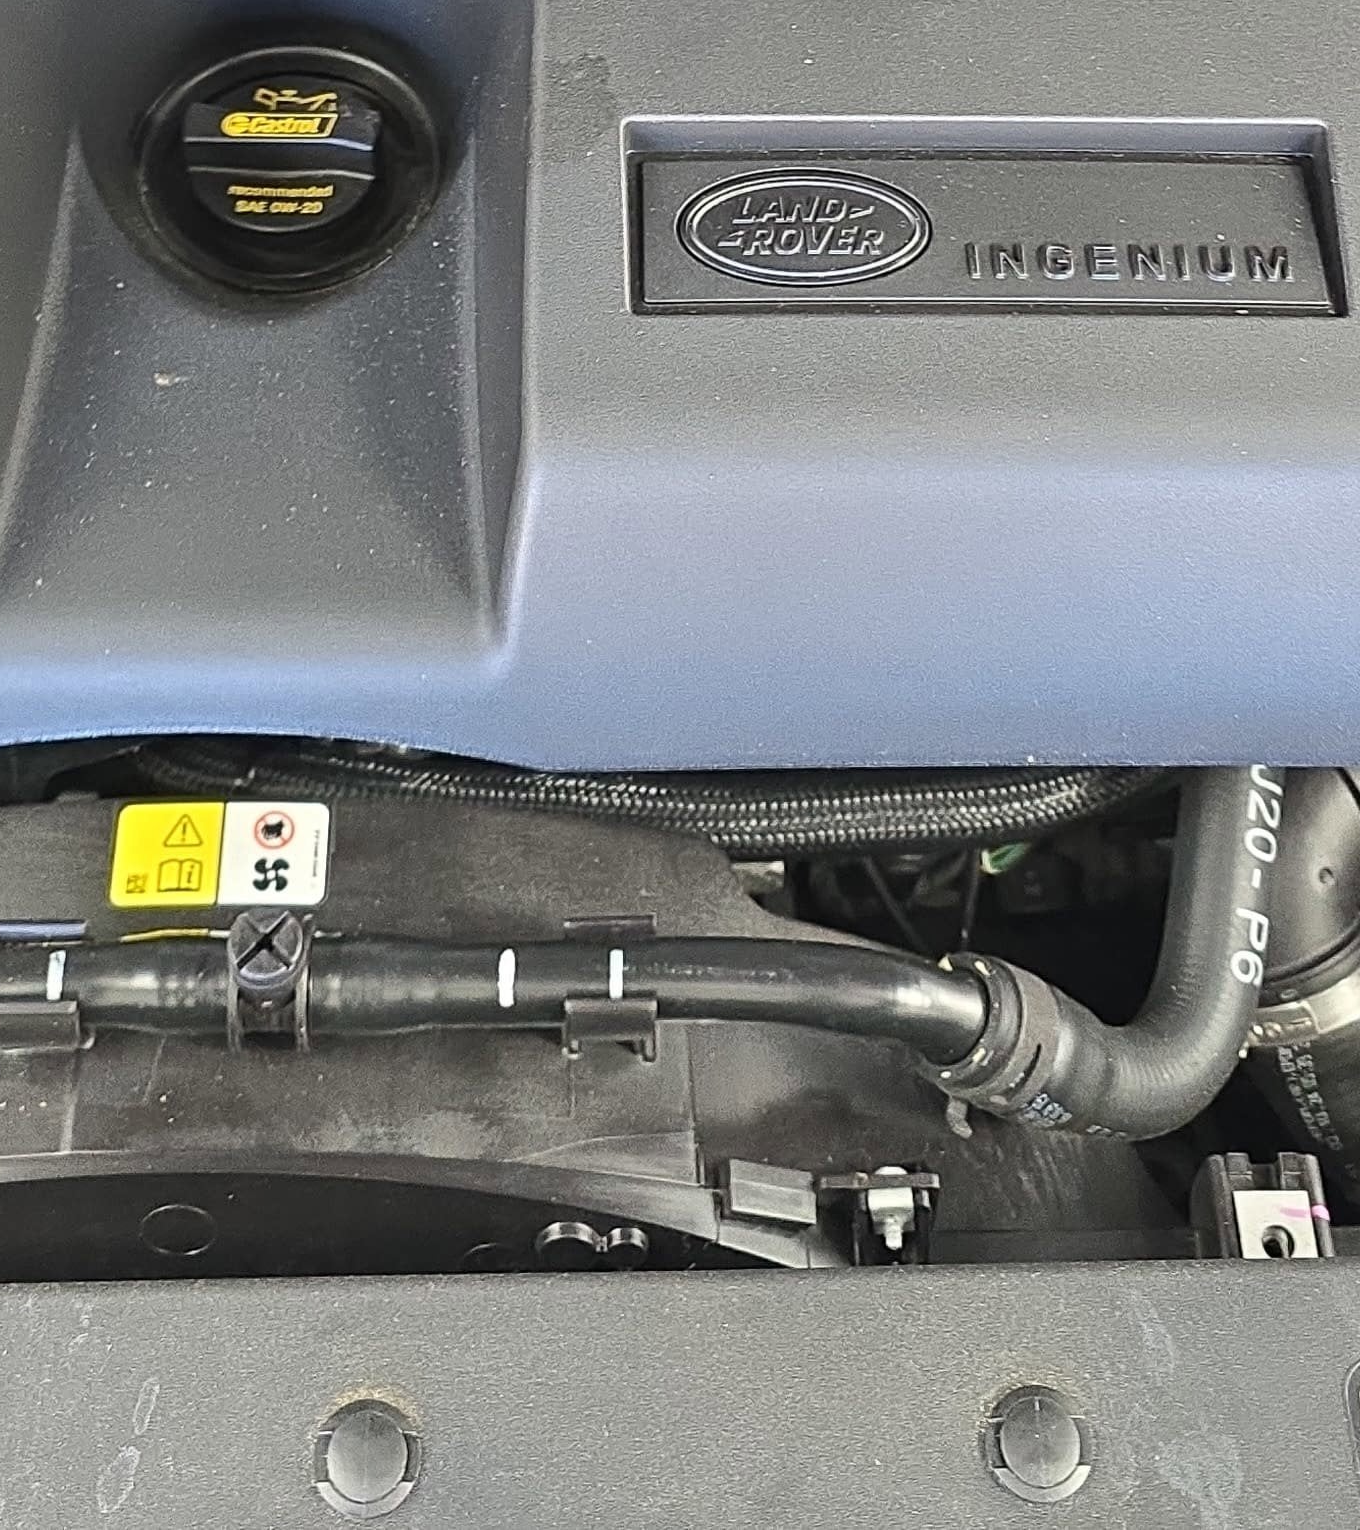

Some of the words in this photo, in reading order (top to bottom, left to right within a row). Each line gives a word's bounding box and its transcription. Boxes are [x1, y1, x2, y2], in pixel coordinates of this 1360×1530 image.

[226, 184, 334, 198] recommended
[234, 200, 269, 213] SAE
[732, 195, 848, 225] LAND
[741, 225, 885, 256] ROVER
[964, 241, 1296, 283] INGENIUM
